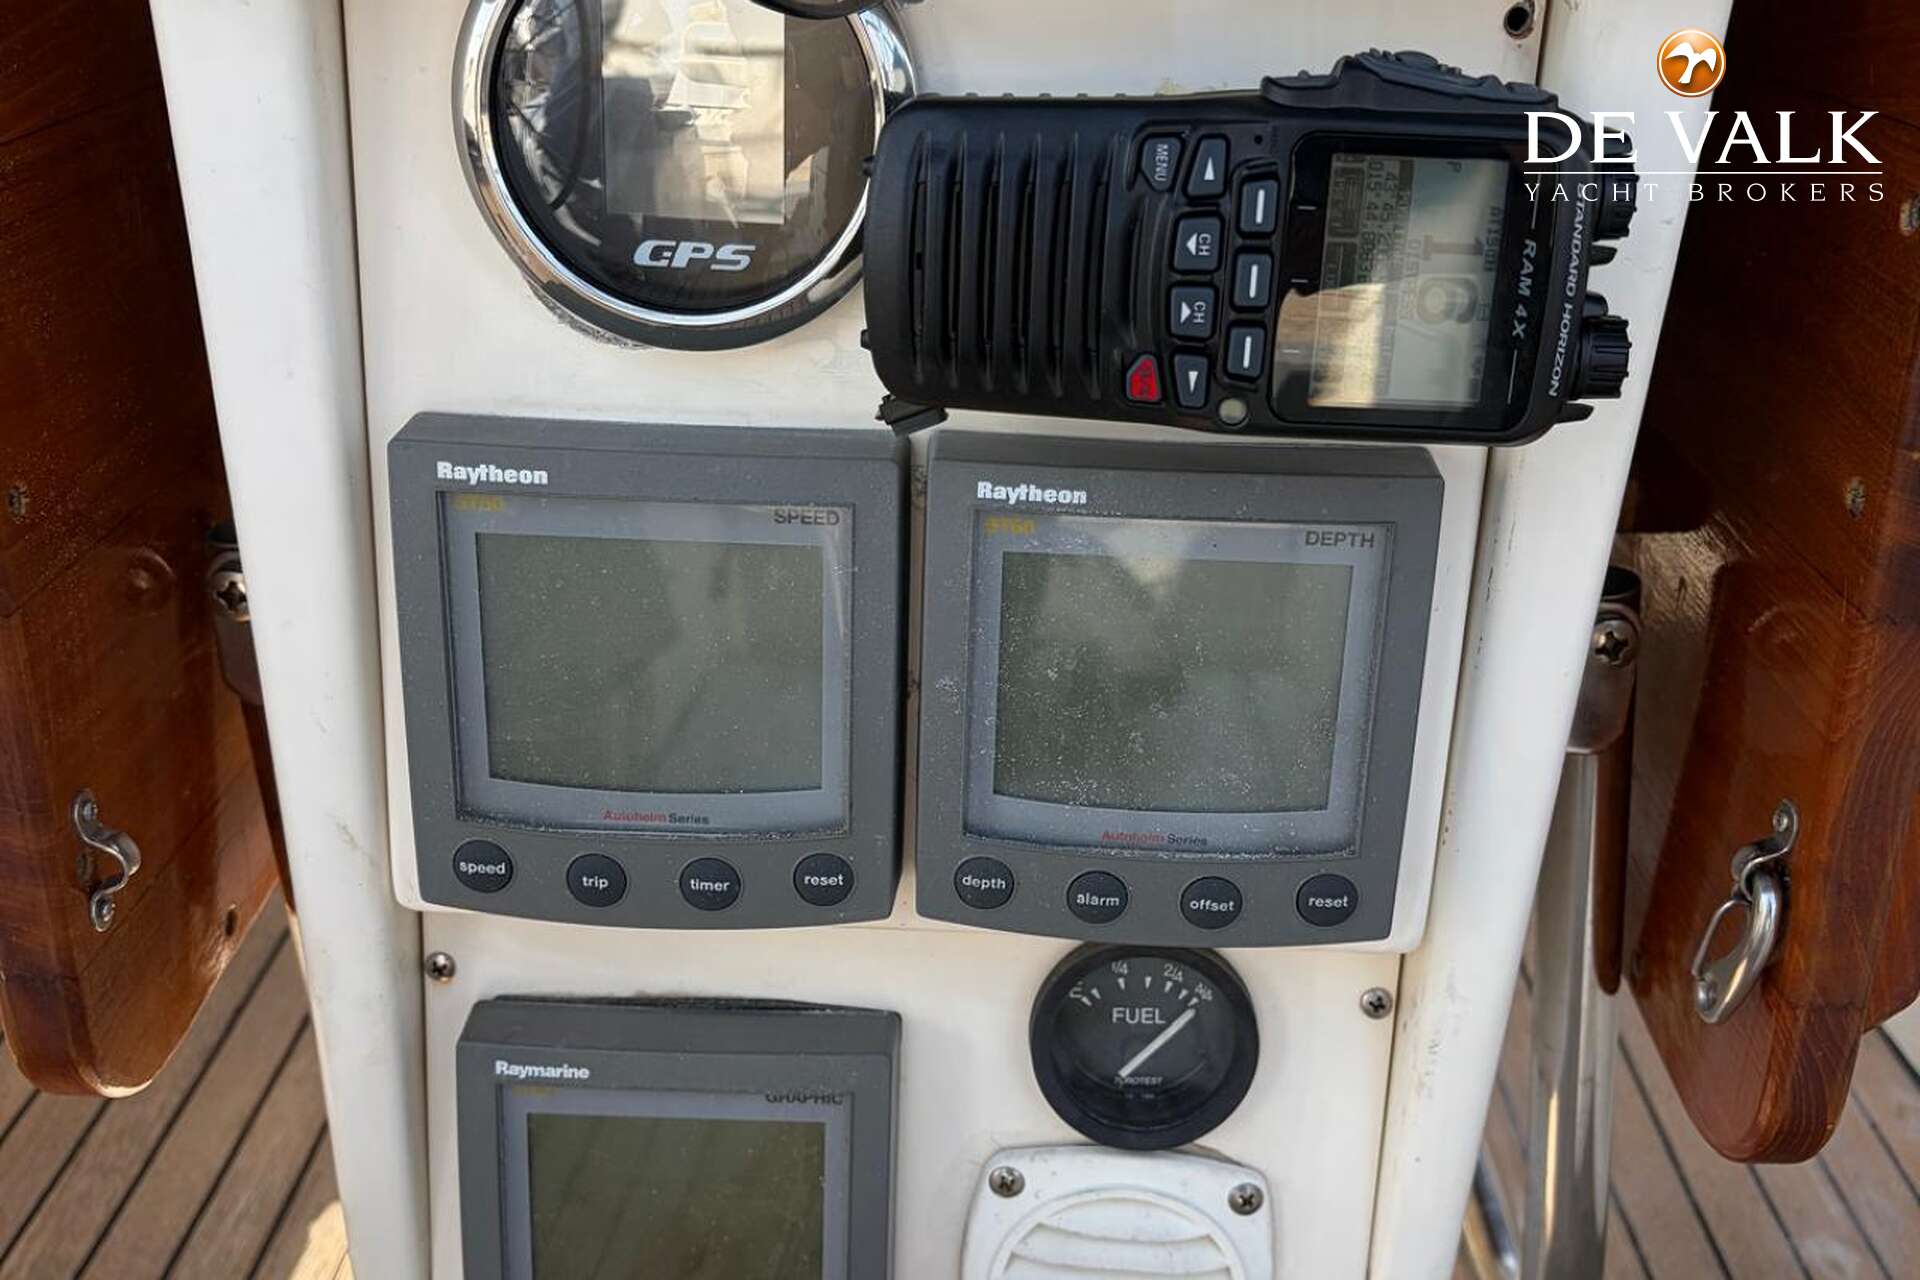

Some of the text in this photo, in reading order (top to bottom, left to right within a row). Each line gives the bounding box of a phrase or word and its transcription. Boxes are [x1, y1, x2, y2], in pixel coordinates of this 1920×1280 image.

[1154, 143, 1169, 182] MENU
[1198, 233, 1212, 256] CH
[632, 239, 756, 272] GPS
[1511, 238, 1537, 340] RAM 4X
[1546, 181, 1587, 398] STANDARD HORIZON
[1192, 301, 1206, 324] CH
[436, 461, 549, 487] Raytheon
[977, 480, 1087, 505] Raytheon
[773, 507, 840, 527] SPEED
[1304, 529, 1376, 549] DEPTH
[668, 812, 710, 826] Series
[459, 858, 506, 877] speed
[581, 874, 609, 891] trip
[689, 876, 731, 893] timer
[804, 872, 845, 888] reset
[962, 873, 1006, 892] depth
[1076, 891, 1120, 907] alarm
[1189, 897, 1235, 915] offset
[1307, 893, 1349, 910] reset
[1111, 1007, 1167, 1025] FUEL
[494, 1059, 591, 1081] Raymarine
